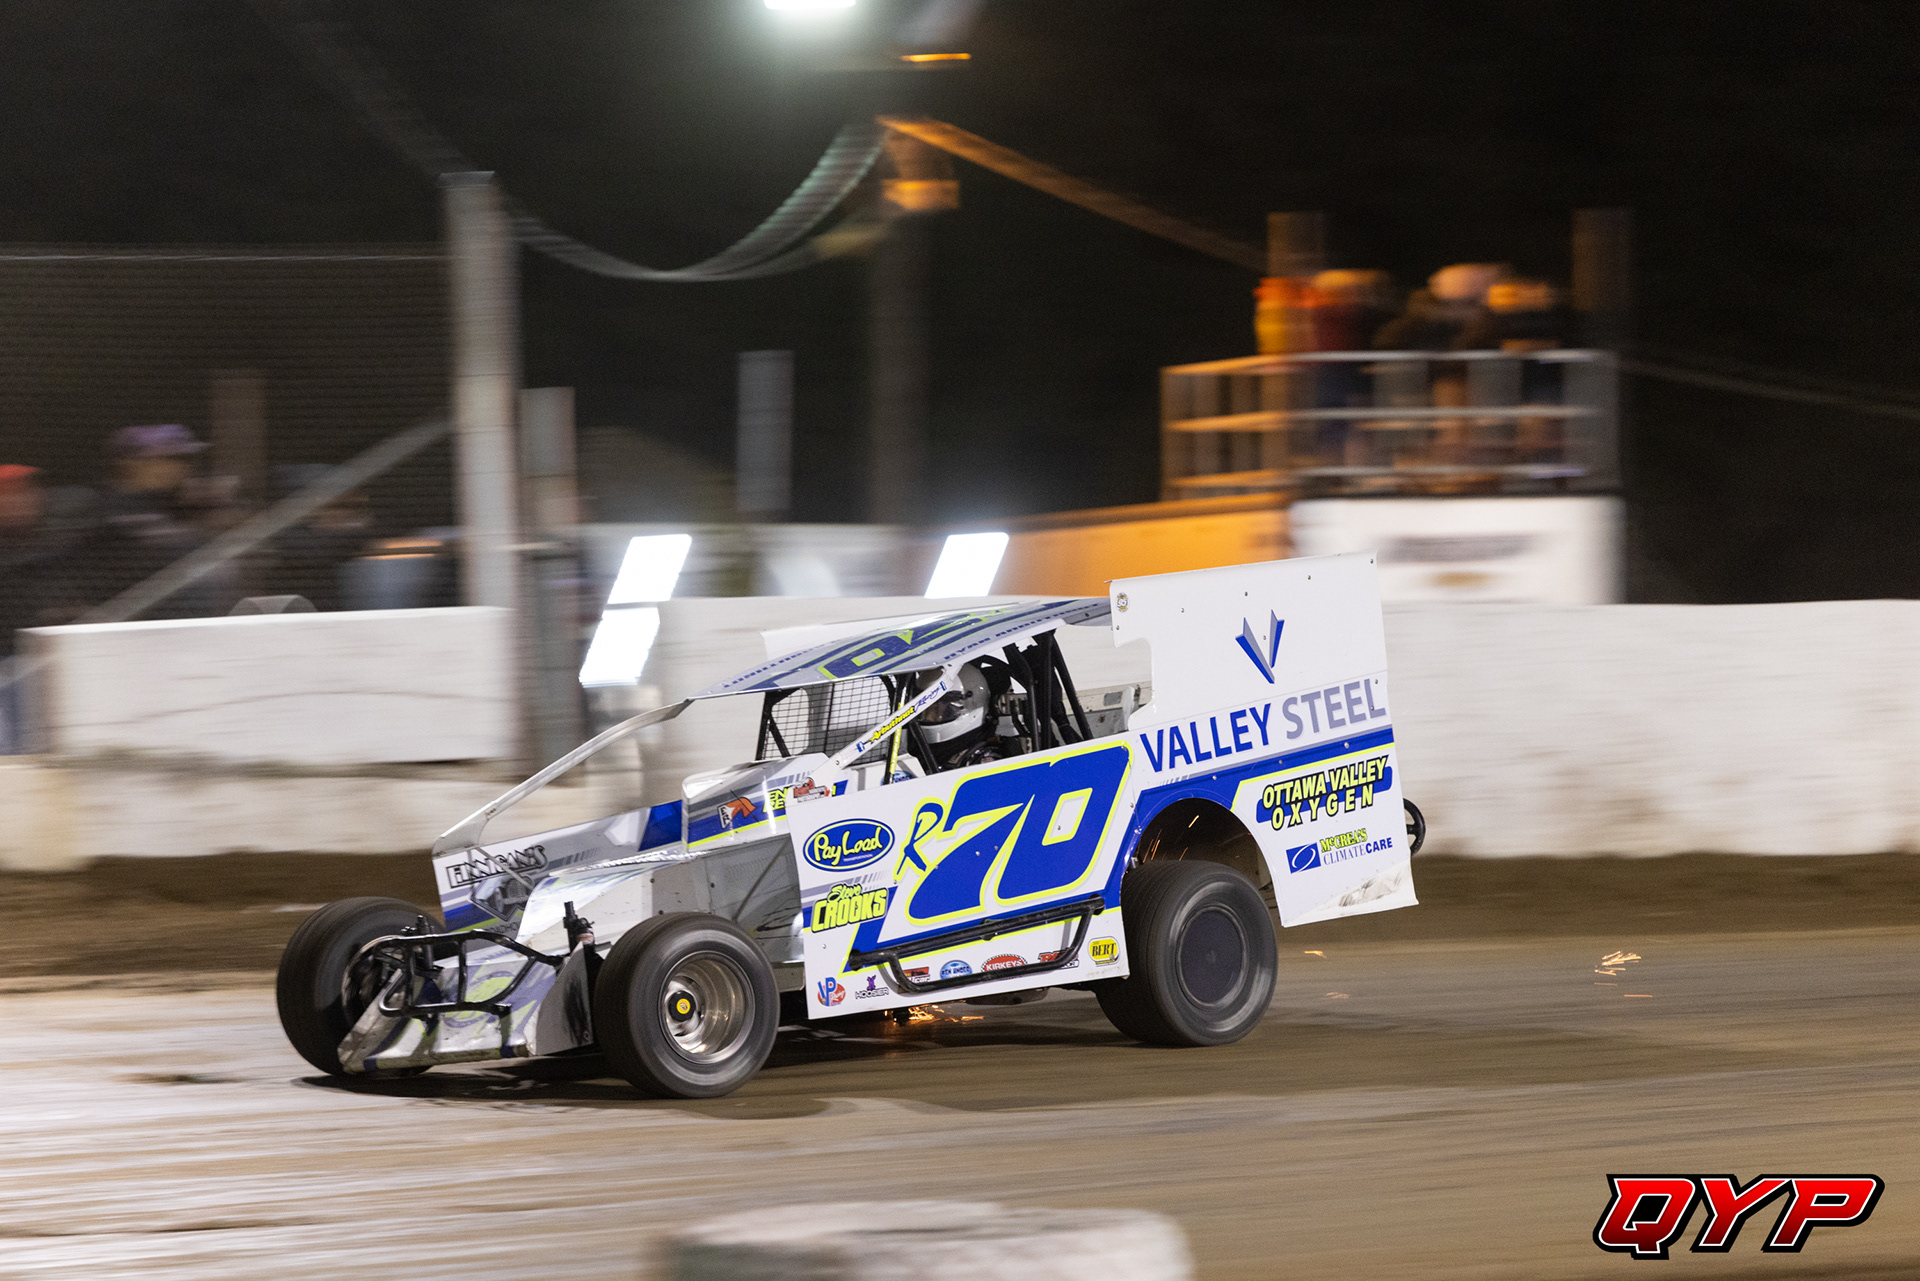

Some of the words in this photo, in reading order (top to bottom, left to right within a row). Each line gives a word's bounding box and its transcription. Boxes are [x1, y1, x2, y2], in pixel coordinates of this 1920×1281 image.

[1140, 703, 1271, 773] VALLEY
[1282, 678, 1387, 740] STEEL
[1262, 771, 1327, 810] OTTAWA
[1328, 754, 1389, 792] VALLEY
[1271, 784, 1374, 831] OXYGEN
[811, 887, 888, 933] CROOKS
[1092, 942, 1117, 957] BERT
[817, 977, 837, 1007] VP
